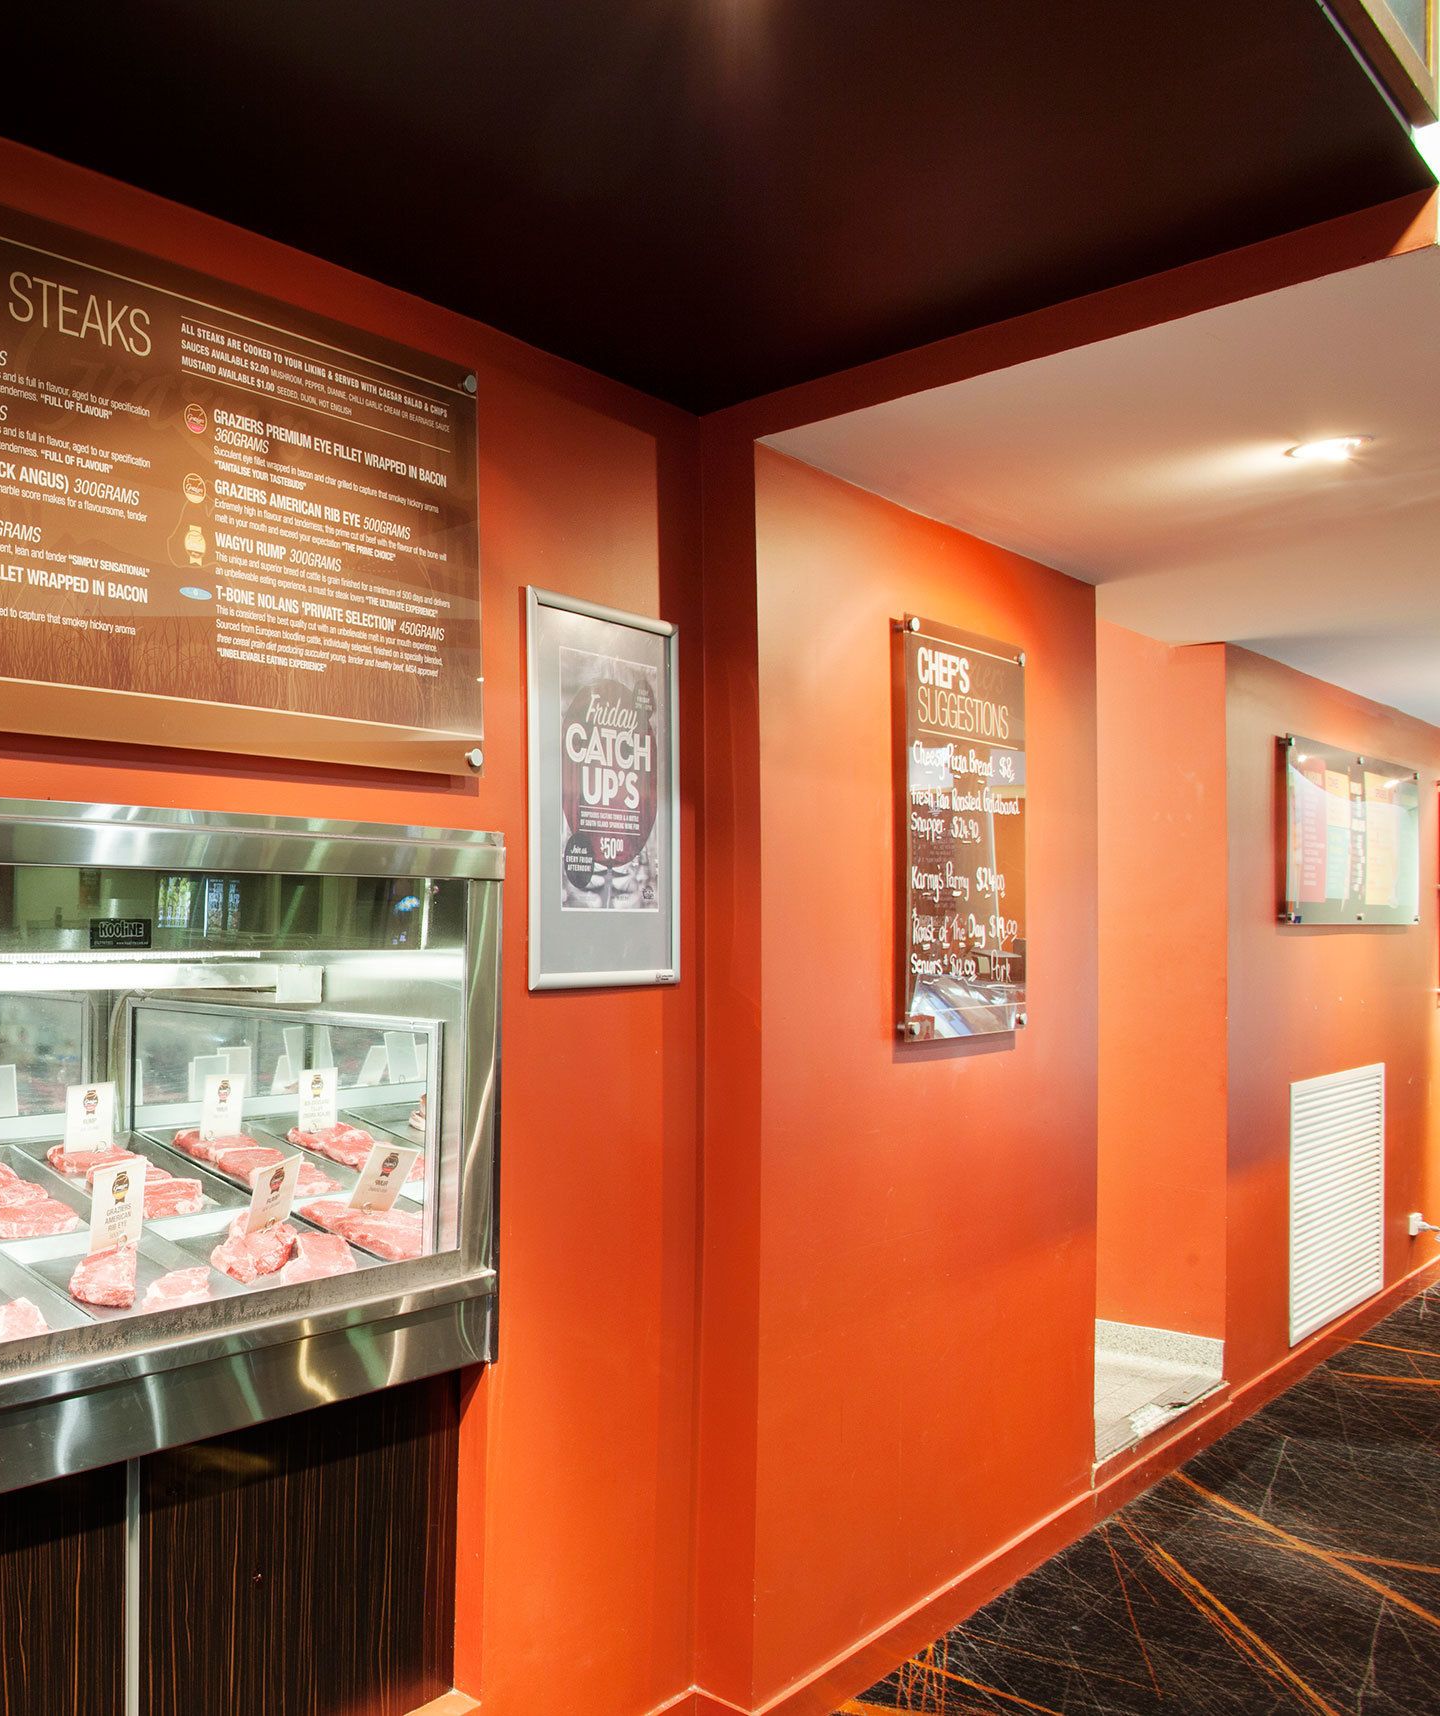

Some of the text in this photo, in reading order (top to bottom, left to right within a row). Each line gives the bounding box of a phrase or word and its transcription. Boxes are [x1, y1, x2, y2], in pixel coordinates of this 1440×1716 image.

[8, 271, 152, 358] STEAKS
[181, 340, 268, 376] SAUCES AVAILABLE $2.00
[181, 323, 447, 417] ALL STEAKS ARE COOKED TO YOUR LIKING & SERVED WITH CAESAR SALAD & CHIPS
[182, 357, 274, 393] MUSTARD AVAILABLE $1.00
[214, 428, 269, 454] 360GRAMS
[214, 409, 446, 487] GRAZIERS PREMIUM EYE FILLET WRAPPED IN BACON
[19, 466, 68, 491] ANGUS)
[74, 477, 139, 505] 300GRAMS
[215, 479, 410, 540] GRAZIERS AMERICAN RIB EYE 500GRAMS
[215, 533, 341, 572] WAGYU RUMP 300GRAMS
[26, 569, 88, 594] WRAPPED
[92, 580, 104, 596] IN
[108, 582, 148, 603] BACON
[216, 586, 254, 606] T-BONE
[258, 593, 298, 614] NOLANS
[399, 620, 444, 640] 450GRAMS
[586, 694, 638, 738] Friday
[917, 686, 1009, 739] SUGGESTIONS
[566, 723, 651, 772] CATCH
[913, 741, 945, 780] Cheesy
[947, 743, 968, 774] Pizza
[911, 785, 933, 809] Fresh
[952, 788, 982, 811] Roasted
[913, 917, 936, 944] Roast
[939, 916, 948, 940] of
[950, 914, 966, 941] The
[968, 914, 986, 948] Day
[990, 949, 1011, 983] Pork
